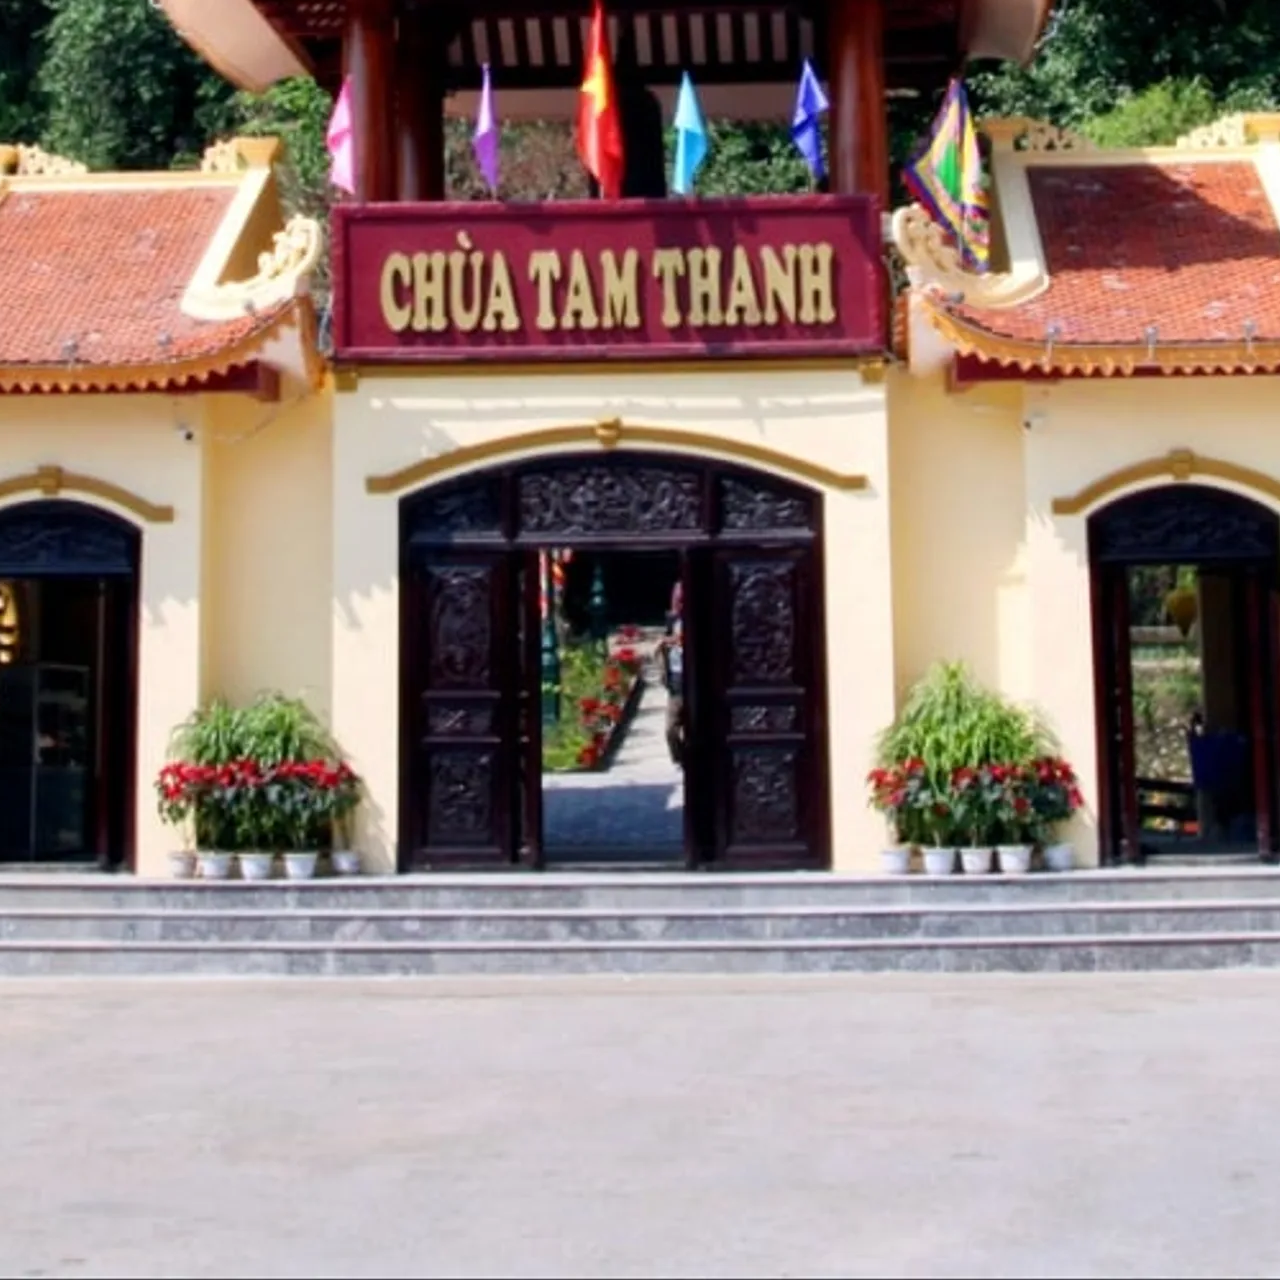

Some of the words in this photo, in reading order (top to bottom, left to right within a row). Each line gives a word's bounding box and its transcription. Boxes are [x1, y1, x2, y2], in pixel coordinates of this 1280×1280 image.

[380, 230, 520, 332] CHÙA
[529, 247, 638, 331] TAM
[653, 243, 836, 327] THANH
